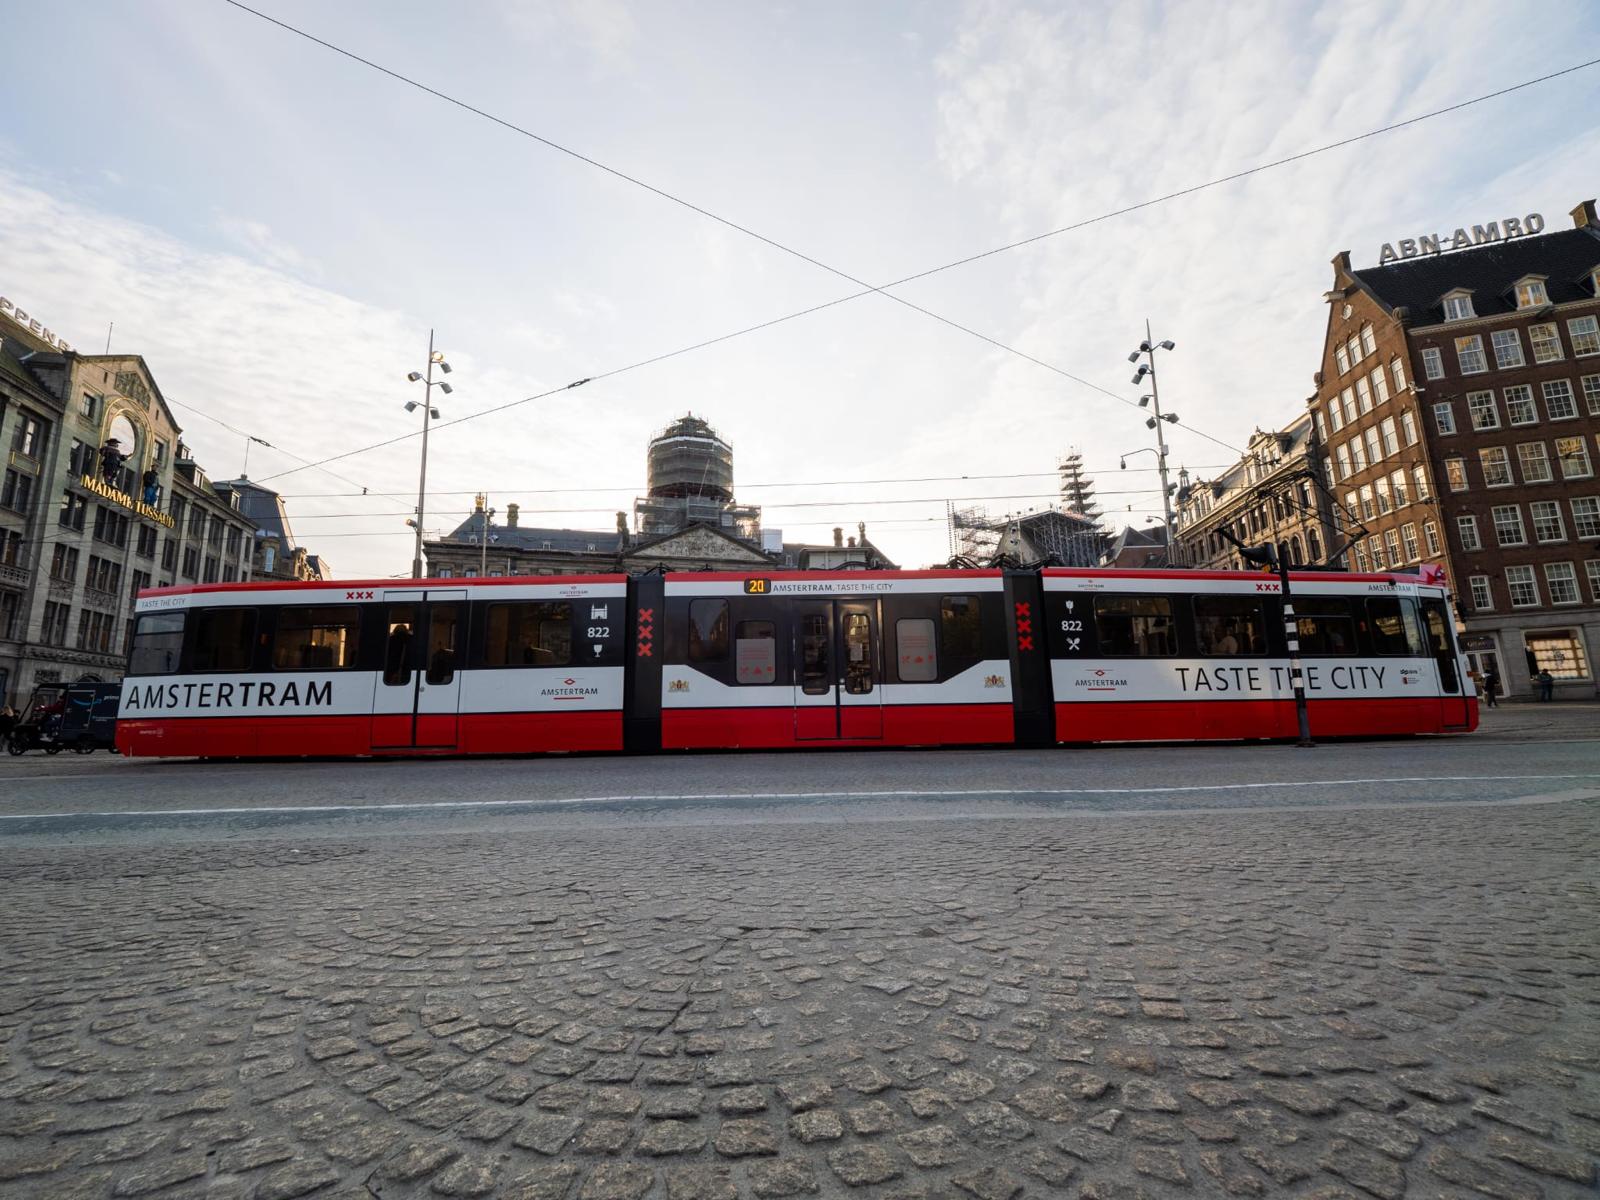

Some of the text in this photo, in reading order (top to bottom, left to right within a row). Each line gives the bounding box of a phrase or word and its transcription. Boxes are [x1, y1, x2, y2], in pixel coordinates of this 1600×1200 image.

[81, 474, 134, 509] MADAME
[749, 579, 764, 593] 20
[876, 583, 893, 591] CITY
[1368, 584, 1411, 592] AMSTERTRAM
[142, 598, 186, 608] TASTE THE CITY
[1061, 620, 1083, 631] 822
[587, 627, 610, 638] 822
[1075, 679, 1128, 687] AMSTERTRAM
[1175, 667, 1262, 691] TASTE
[1331, 666, 1386, 690] CITY
[125, 681, 332, 710] AMSTERTRAM
[541, 687, 598, 696] AMSTERTRAM
